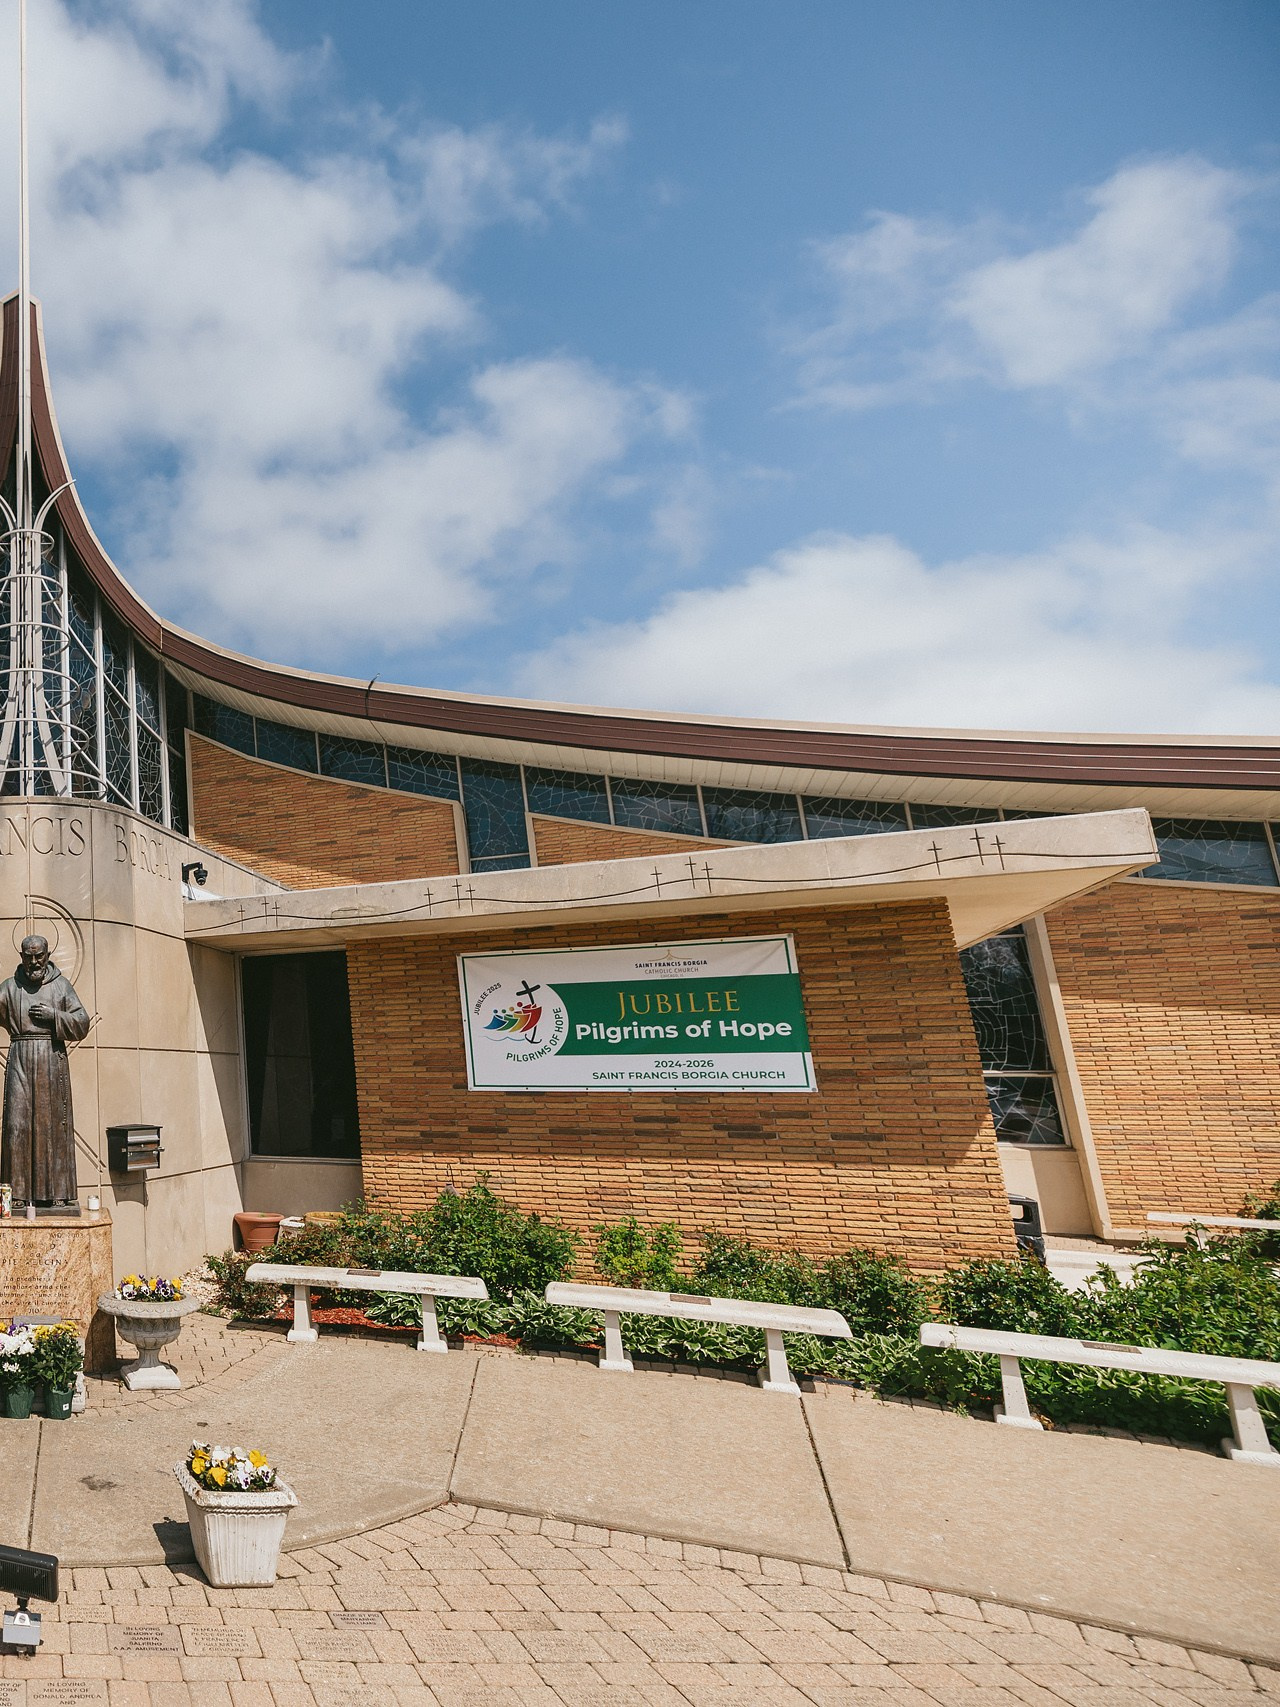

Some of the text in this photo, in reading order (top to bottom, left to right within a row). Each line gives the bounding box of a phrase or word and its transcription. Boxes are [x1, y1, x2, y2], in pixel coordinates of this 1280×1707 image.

[474, 982, 502, 1015] JUBILEE 2025
[618, 990, 740, 1022] JUBILEE
[506, 1007, 564, 1062] PILGRIMS OF HOPE
[575, 1019, 793, 1044] Pilgrims of Hope
[592, 1071, 786, 1080] SAINT FRANCIS BORGIA CHURCH
[654, 1059, 715, 1068] 2024-2026
